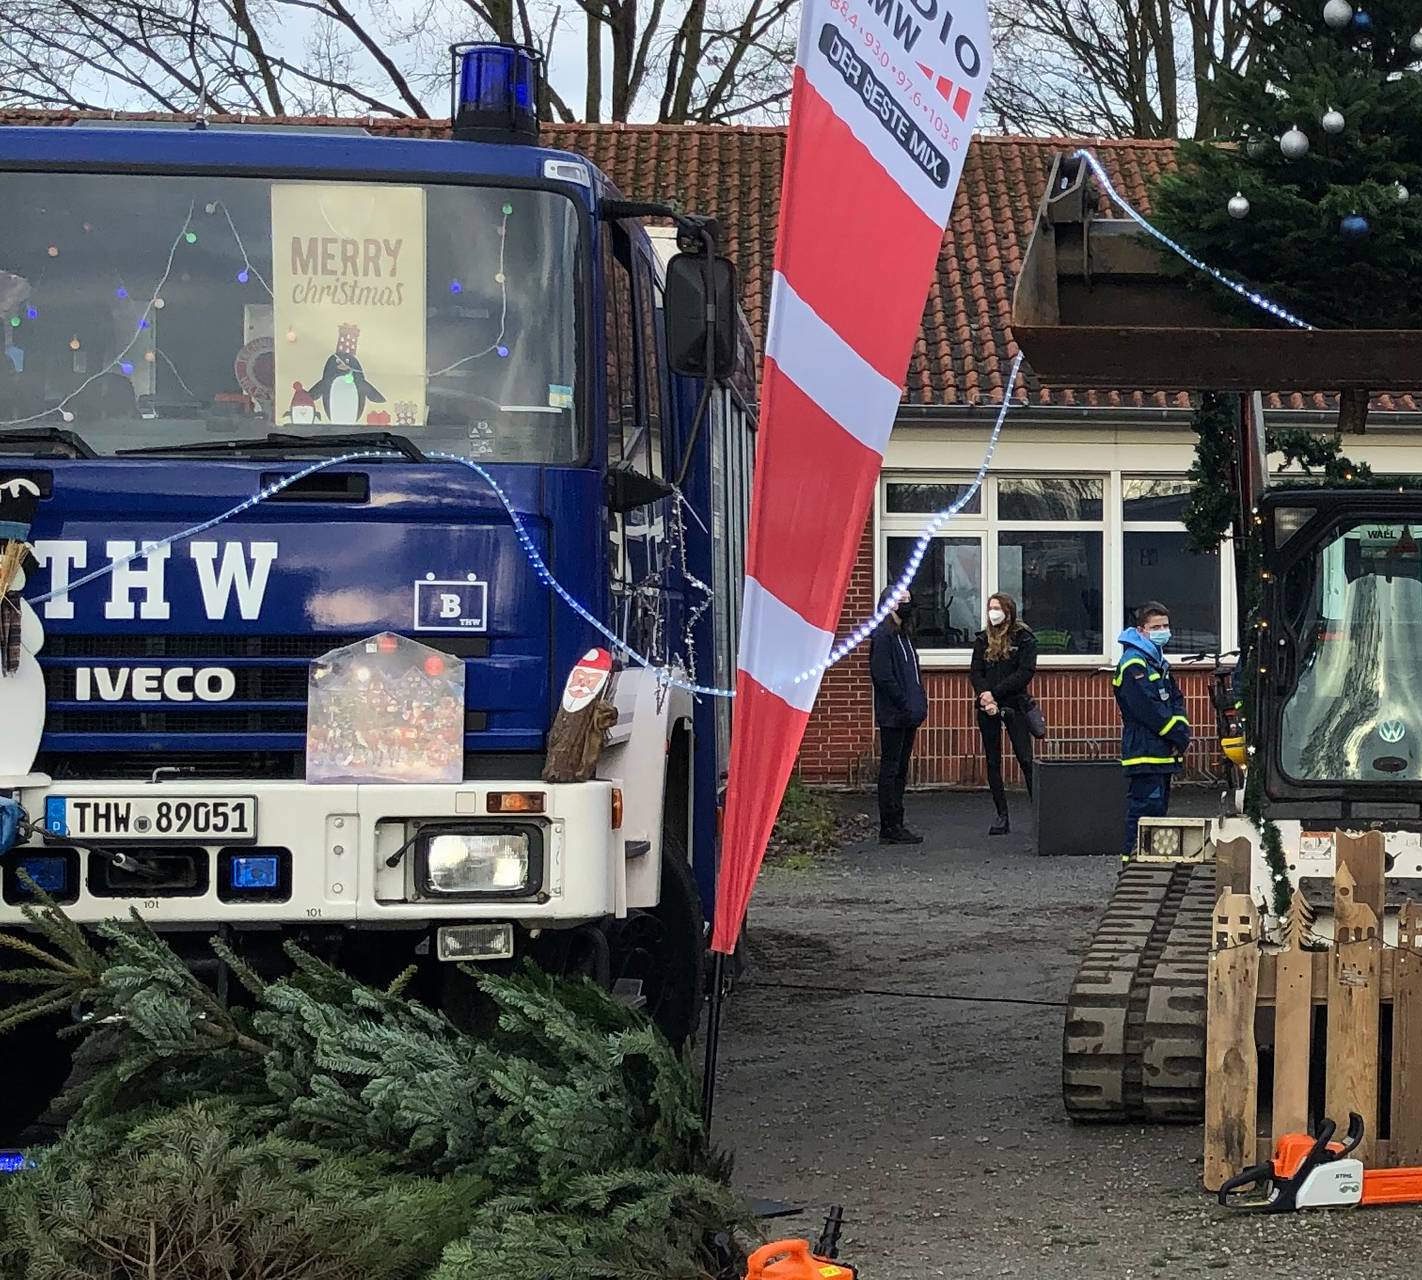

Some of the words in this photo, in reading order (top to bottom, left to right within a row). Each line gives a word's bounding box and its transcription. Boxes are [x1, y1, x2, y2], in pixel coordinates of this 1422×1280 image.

[829, 37, 861, 84] DER
[863, 77, 910, 142] BESTE
[909, 131, 943, 182] MIX.
[290, 236, 403, 278] MERRY
[291, 275, 404, 308] christmas
[35, 540, 279, 620] THW
[440, 593, 462, 619] B
[459, 618, 481, 626] THW
[75, 667, 236, 702] IVECO
[52, 821, 61, 831] D
[73, 802, 131, 833] THW
[156, 801, 248, 833] 89051
